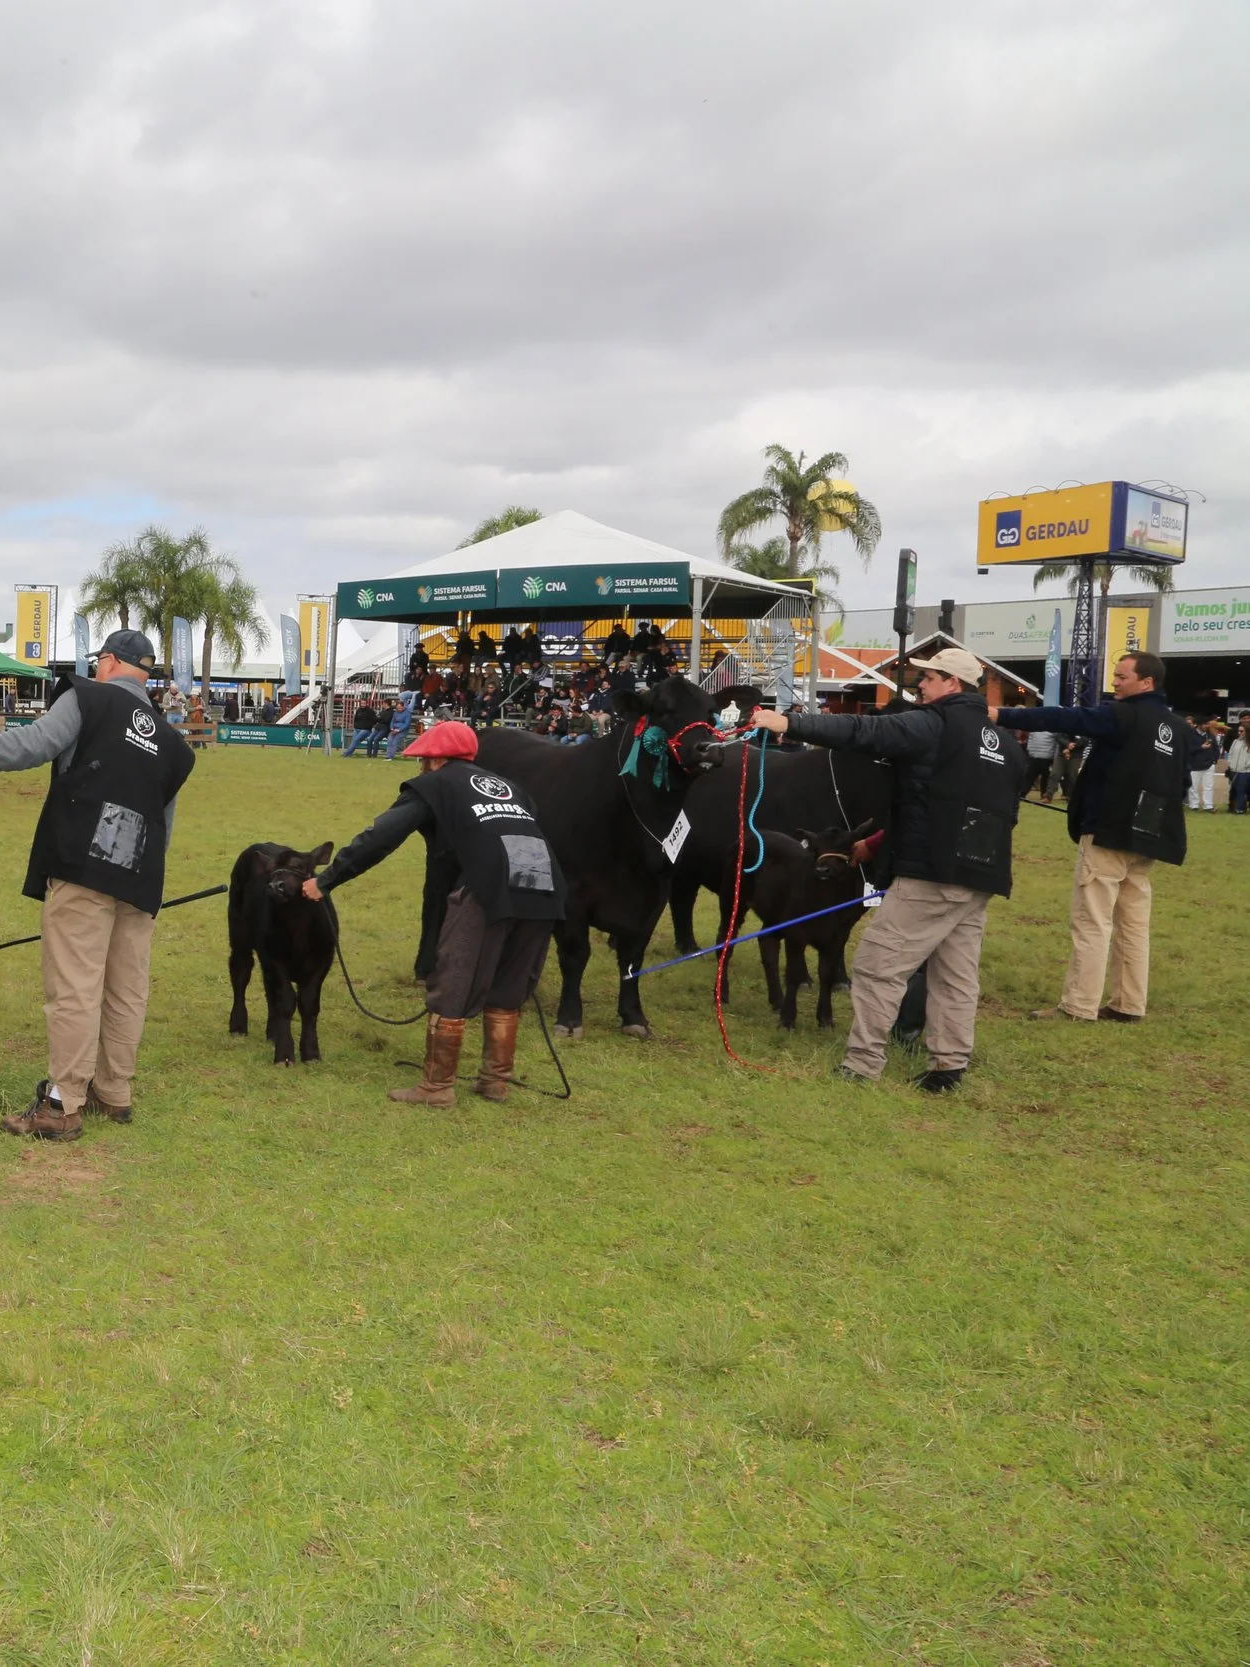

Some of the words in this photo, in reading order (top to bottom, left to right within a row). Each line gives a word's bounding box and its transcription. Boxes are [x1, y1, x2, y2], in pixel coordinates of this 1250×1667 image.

[1025, 518, 1090, 541] GERDAU
[545, 581, 567, 592] CNA
[614, 578, 648, 587] SISTEMA
[648, 577, 679, 586] FARSUL
[433, 586, 461, 595] SISTEMA
[461, 584, 487, 593] FARSUL
[376, 592, 395, 602] CNA
[1175, 602, 1227, 617] Vamos
[33, 599, 42, 639] GERDAU
[1174, 620, 1200, 634] pelo
[1203, 621, 1224, 631] seu
[126, 727, 159, 751] Brangus
[979, 746, 1005, 761] Brangus
[471, 803, 531, 817] Brang
[669, 820, 684, 847] 1492
